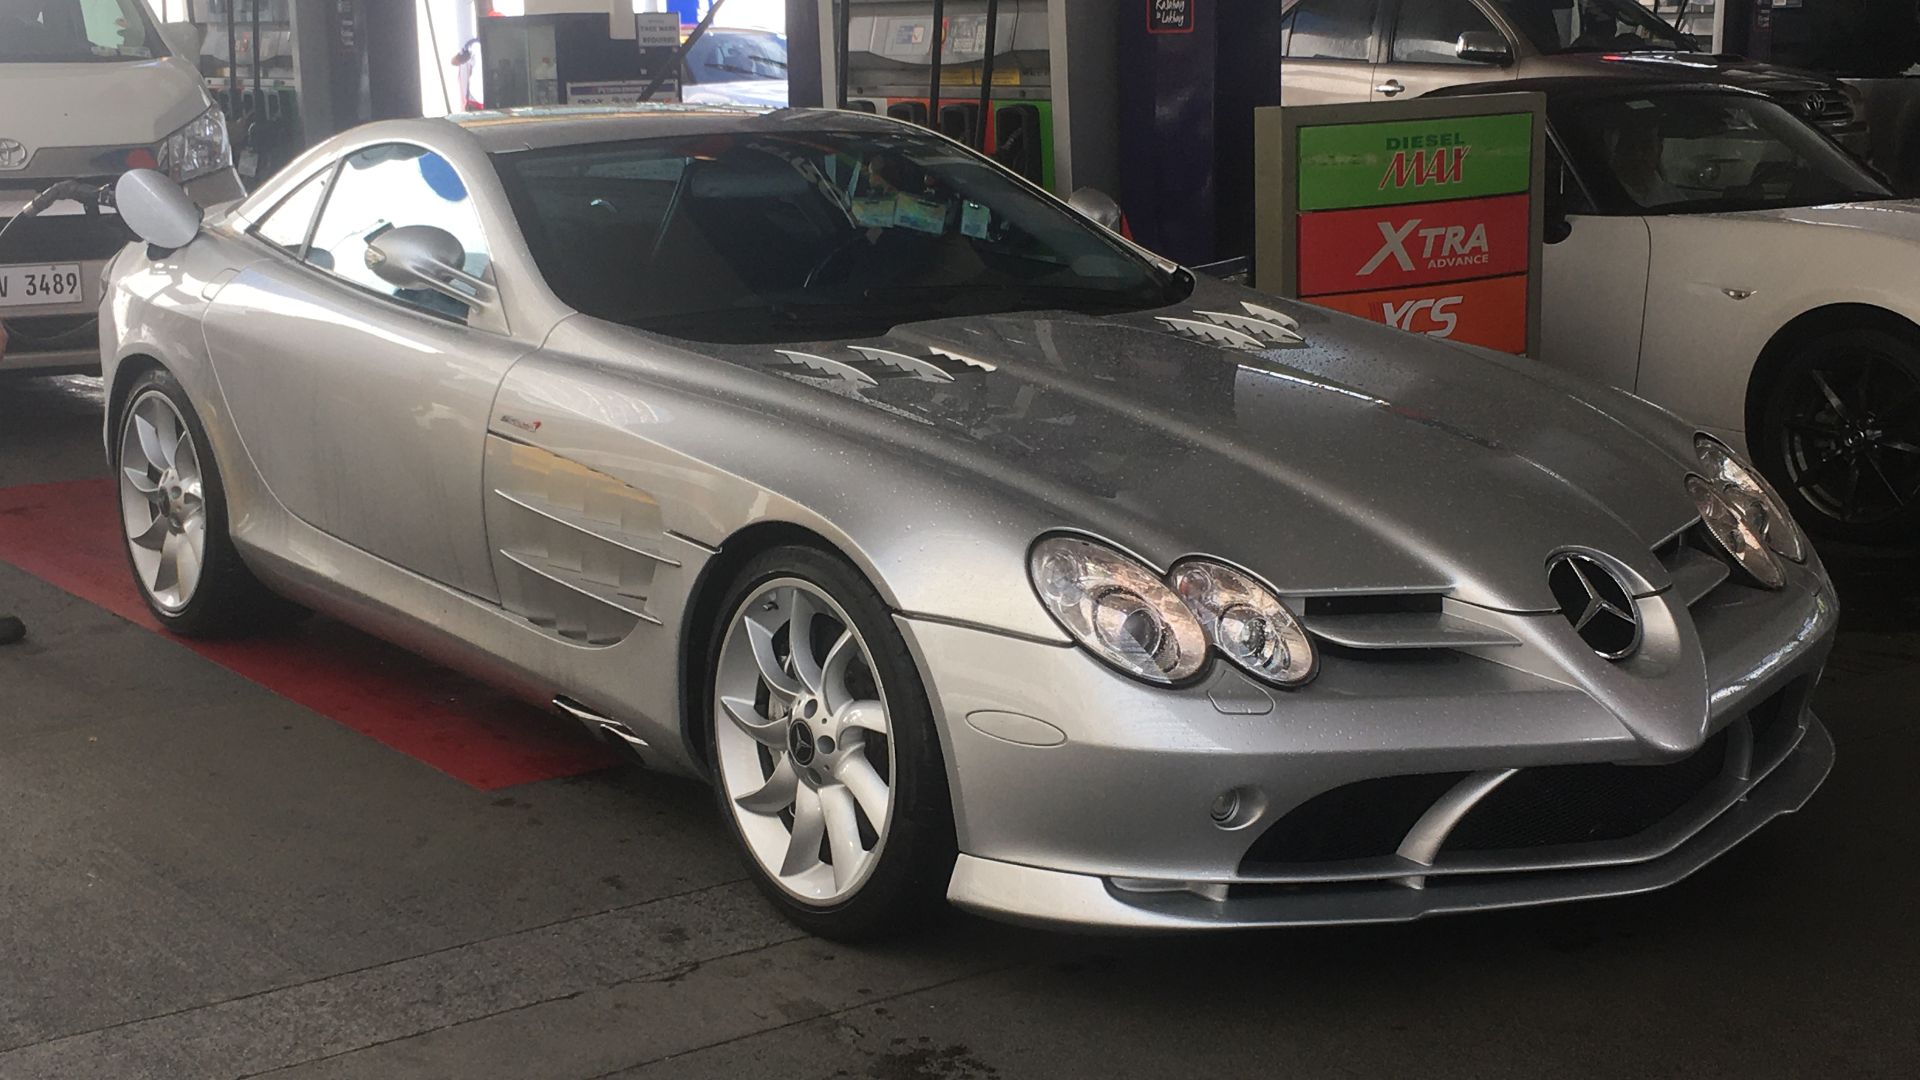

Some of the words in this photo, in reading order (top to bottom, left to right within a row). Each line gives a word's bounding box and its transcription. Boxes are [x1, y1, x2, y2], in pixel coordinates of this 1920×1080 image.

[1385, 132, 1465, 150] DIESEL
[1378, 145, 1471, 190] MAX
[1356, 218, 1489, 276] XTRA
[1427, 254, 1489, 269] ADVANCE
[25, 272, 77, 296] 3489
[1382, 296, 1464, 337] XCS
